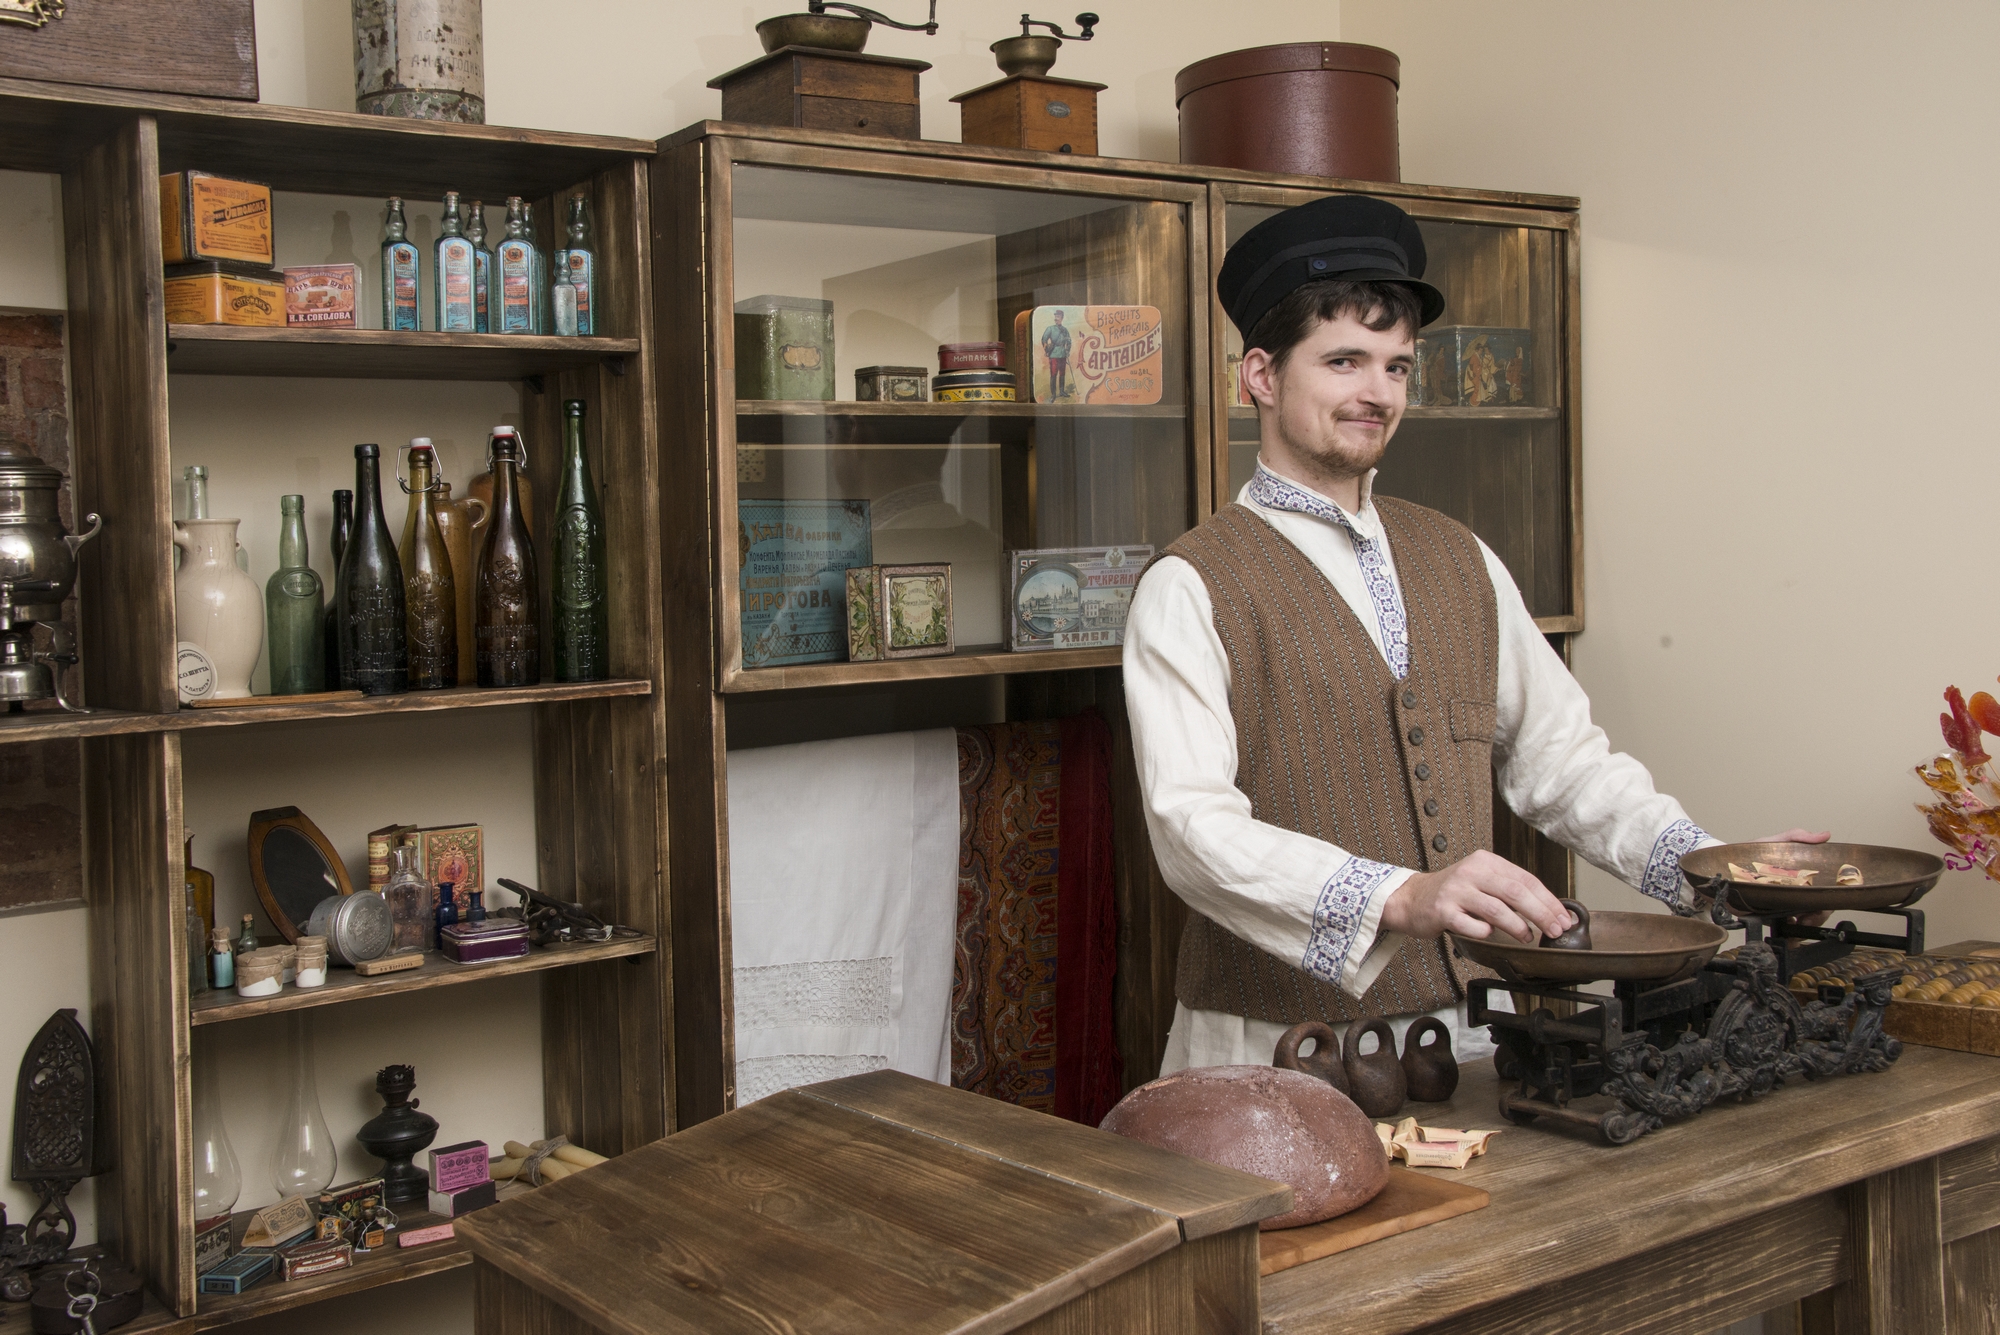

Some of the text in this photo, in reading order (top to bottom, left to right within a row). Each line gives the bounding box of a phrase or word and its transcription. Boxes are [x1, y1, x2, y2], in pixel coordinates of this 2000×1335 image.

[288, 279, 352, 294] ЦАРЬ ПУШКА
[750, 521, 804, 545] ХАЛВА
[1061, 631, 1109, 643] ХАЛВА
